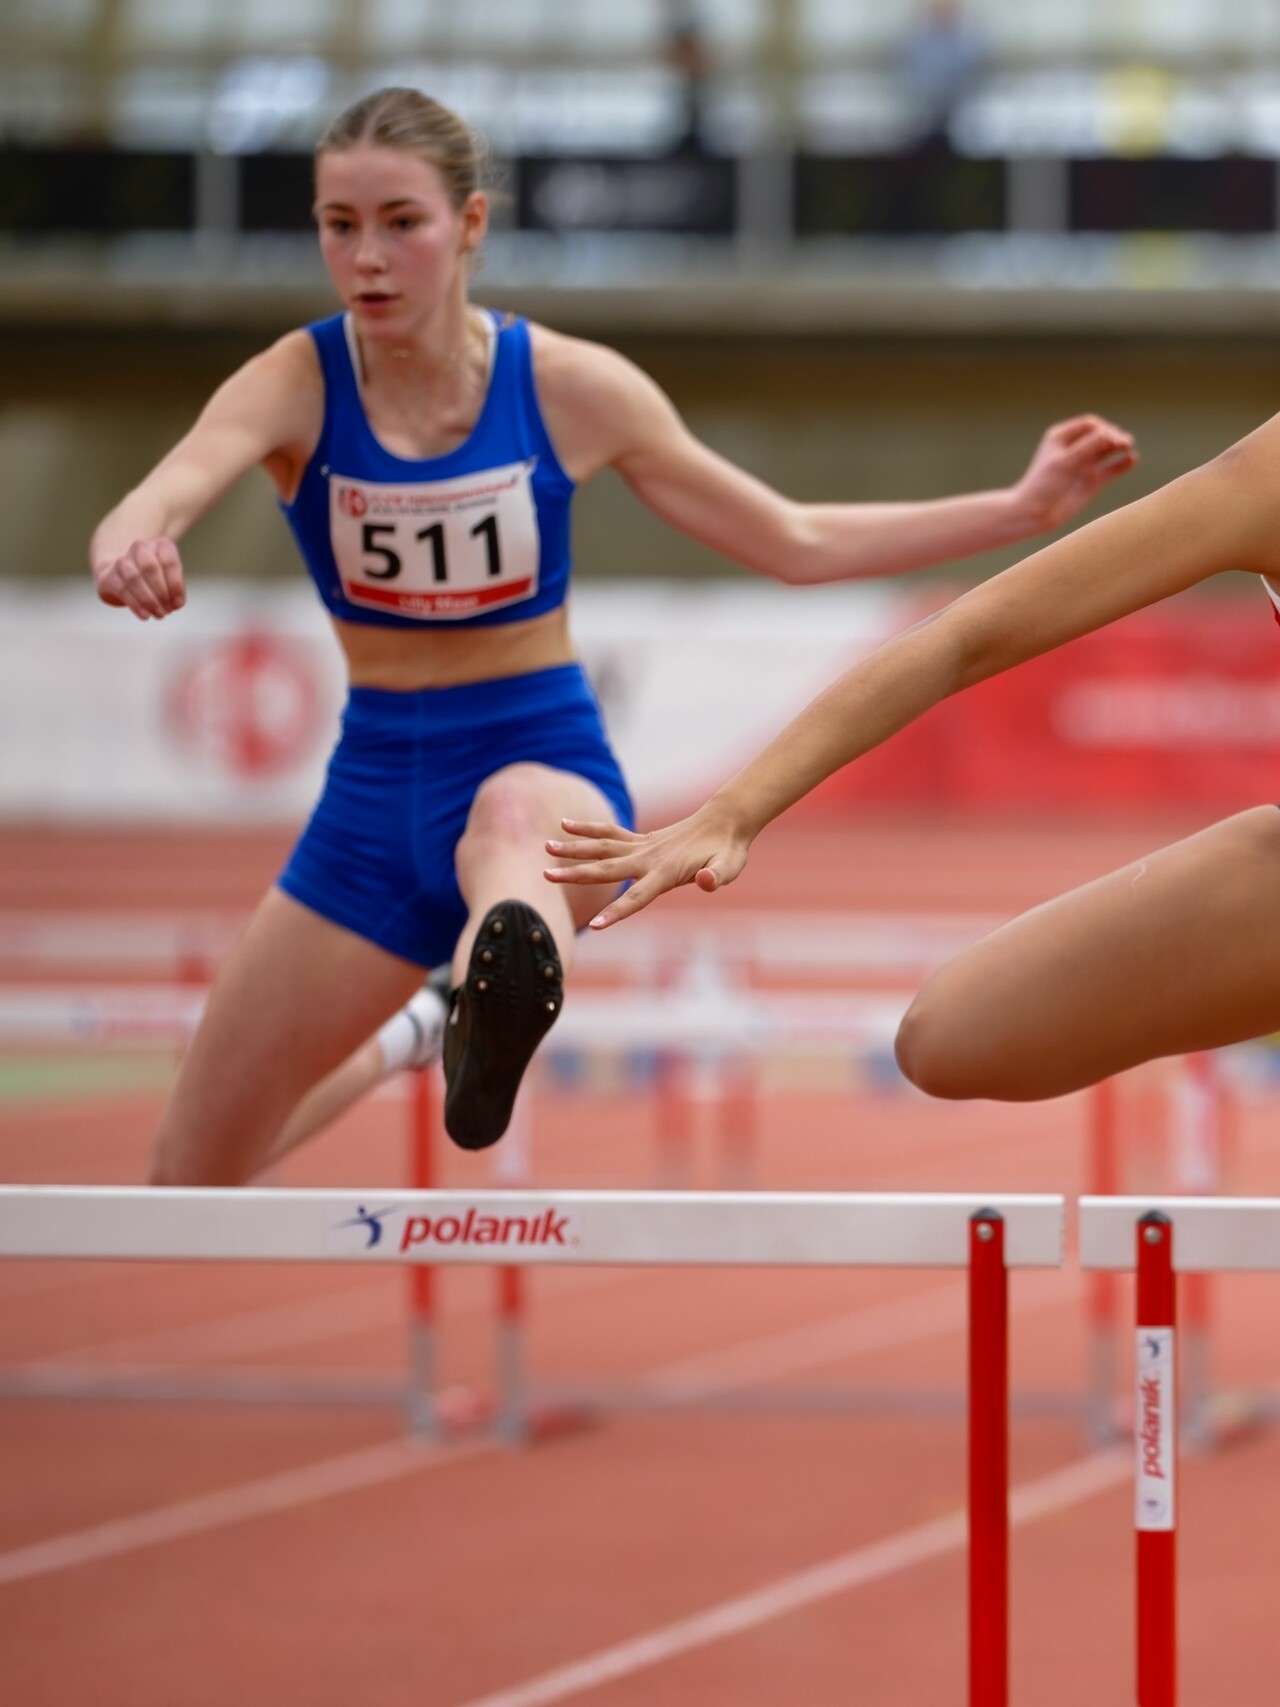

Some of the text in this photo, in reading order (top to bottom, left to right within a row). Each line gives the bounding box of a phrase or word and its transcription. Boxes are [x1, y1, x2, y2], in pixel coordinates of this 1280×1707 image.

[361, 513, 502, 582] 511
[399, 1207, 570, 1252] polanik
[1140, 1376, 1165, 1479] polanik
